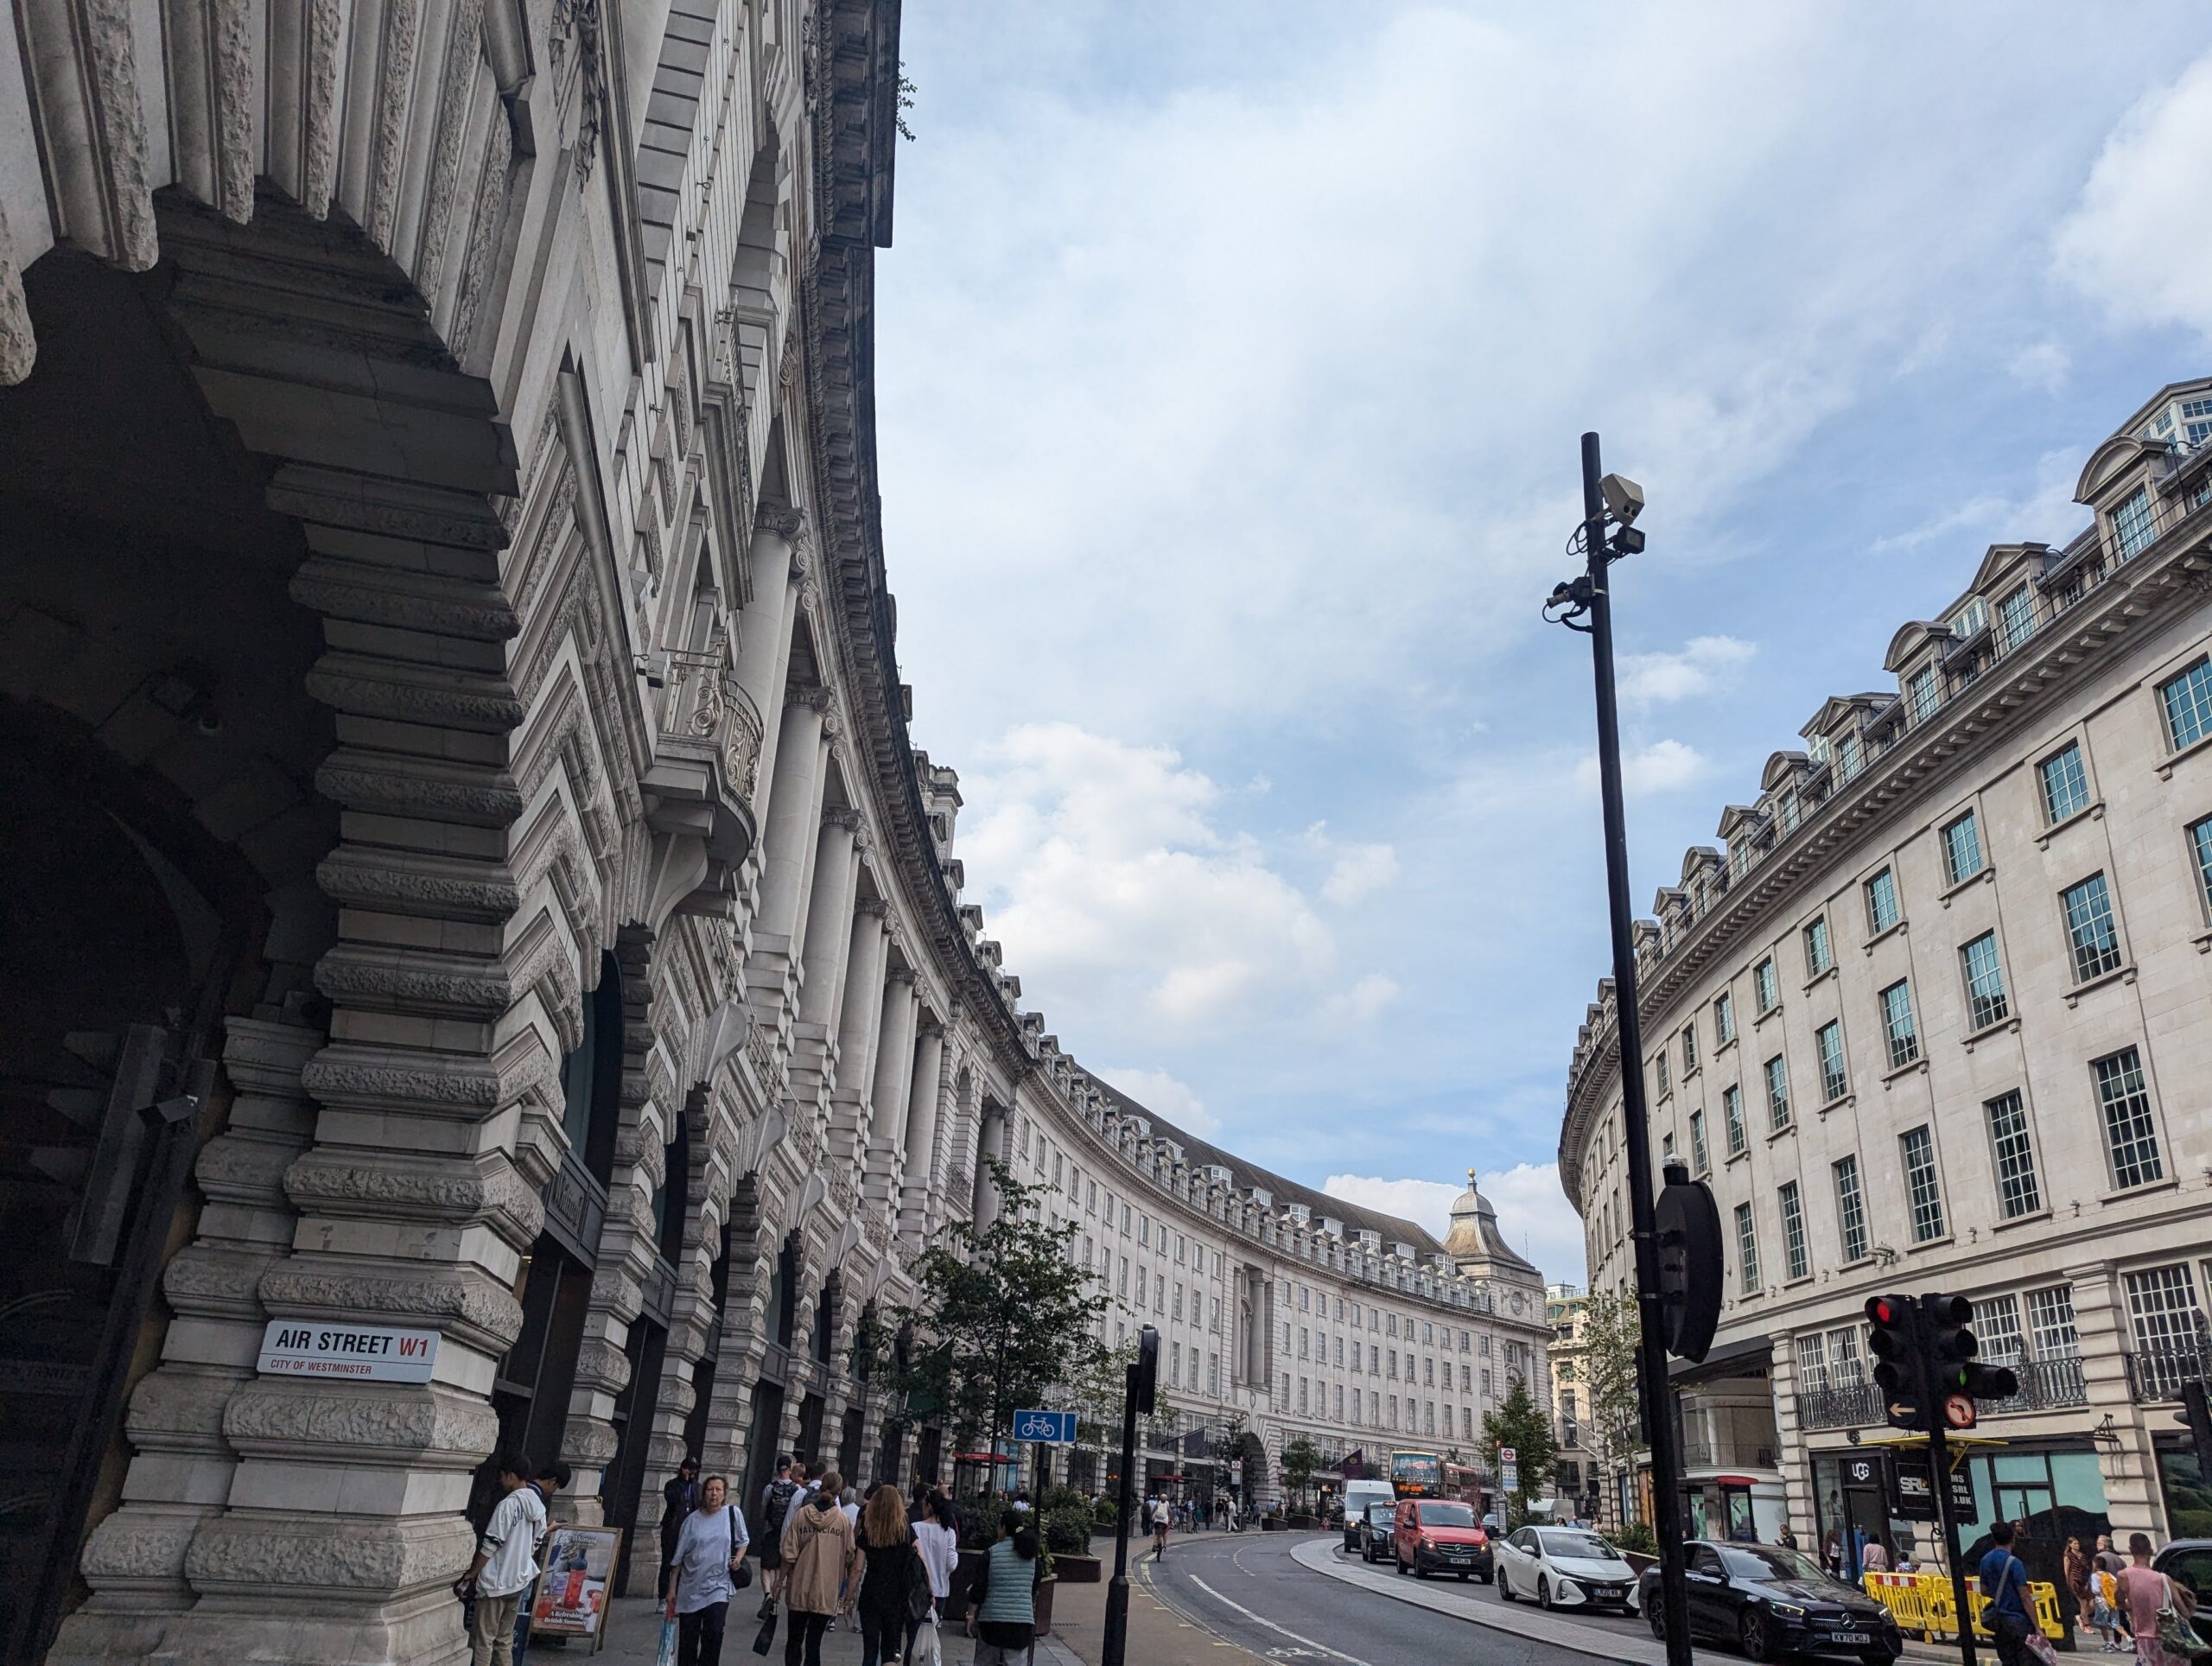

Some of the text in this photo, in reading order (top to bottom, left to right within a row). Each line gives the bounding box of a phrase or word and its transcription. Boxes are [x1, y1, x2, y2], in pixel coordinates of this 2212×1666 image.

[276, 1329, 429, 1358] AIR STREET W1
[270, 1359, 372, 1375] CITY OF WESTMINSTER
[1852, 1462, 1870, 1480] UGG
[1900, 1476, 1929, 1492] SRL
[1952, 1485, 1969, 1494] SRL
[555, 1611, 584, 1619] Refreshing
